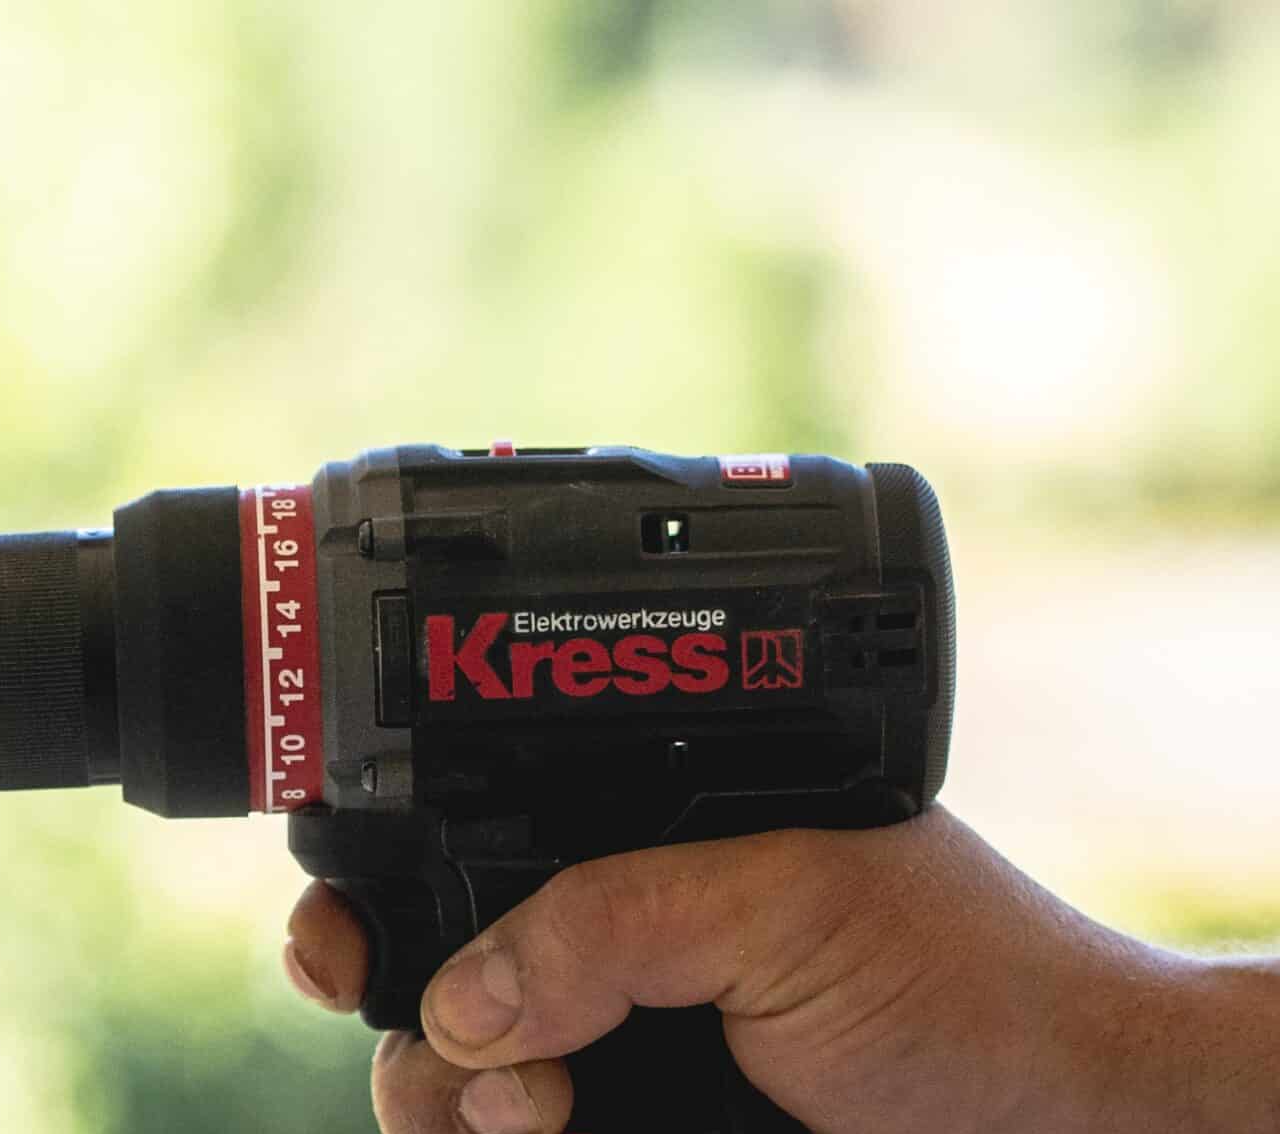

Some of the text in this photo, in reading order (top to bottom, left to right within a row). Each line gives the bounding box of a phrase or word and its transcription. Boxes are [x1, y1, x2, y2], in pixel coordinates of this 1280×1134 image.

[271, 499, 297, 520] 18
[273, 539, 299, 572] 16
[276, 600, 301, 638] 14
[514, 608, 727, 633] Elektrowerkzeuge
[425, 612, 730, 702] Kress
[278, 669, 304, 706] 12
[280, 734, 305, 765] 10
[281, 789, 306, 799] 8
